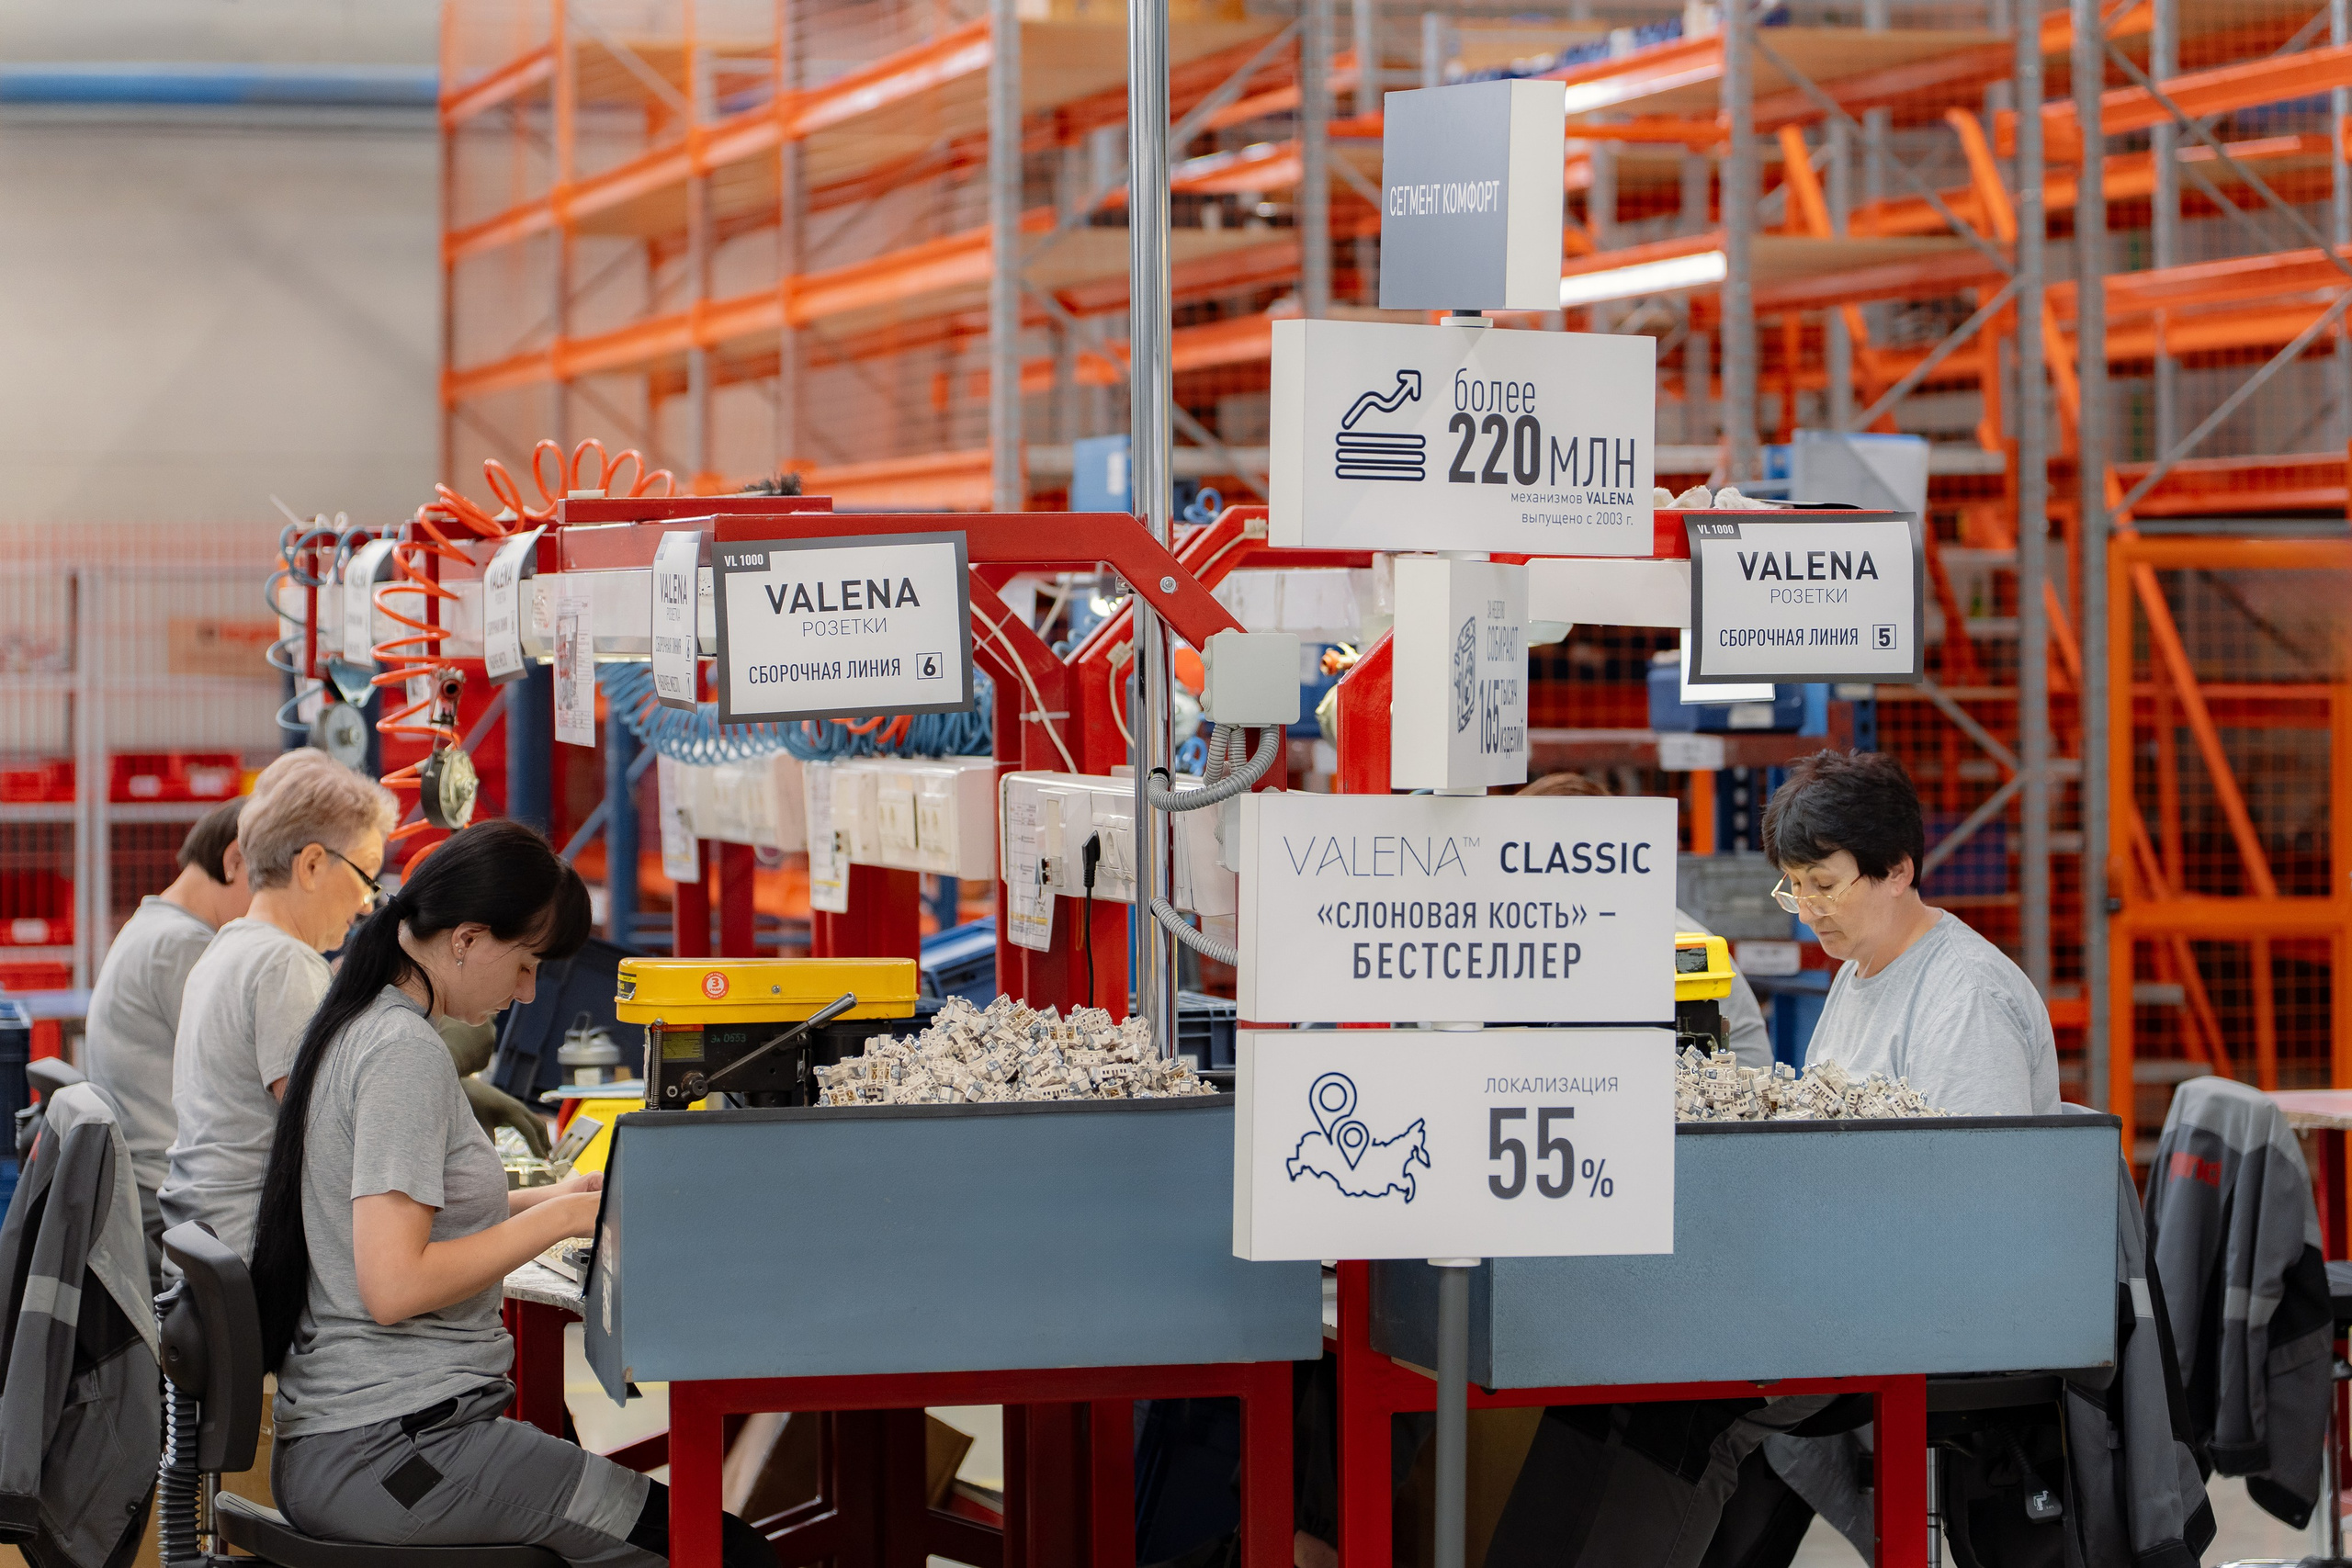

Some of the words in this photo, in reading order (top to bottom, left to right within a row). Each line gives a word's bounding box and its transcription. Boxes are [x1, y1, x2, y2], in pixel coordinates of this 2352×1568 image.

[1389, 183, 1441, 217] СЕГМЕНТ
[1442, 179, 1500, 214] КОМФОРТ
[1454, 367, 1536, 414] более
[1448, 412, 1541, 486] 220
[1510, 492, 1583, 504] механизмов
[1586, 491, 1634, 506] VALENA
[1521, 513, 1583, 527] выпущено
[1586, 515, 1593, 525] с
[1596, 512, 1623, 525] 2003
[1626, 515, 1634, 526] г.
[1696, 524, 1710, 535] VL
[1711, 524, 1735, 535] 1000
[724, 555, 737, 568] VL
[739, 553, 764, 567] 1000
[1736, 550, 1879, 581] VALENA
[660, 573, 687, 604] VALENA
[764, 577, 921, 615] VALENA
[1770, 588, 1849, 604] РОЗЕТКИ
[802, 616, 888, 637] РОЗЕТКИ
[1719, 628, 1804, 647] СБОРОЧНАЯ
[1808, 627, 1859, 646] ЛИНИЯ
[1878, 627, 1891, 647] 5
[1487, 625, 1519, 661] СОБИРАЮТ
[749, 660, 842, 684] СБОРОЧНАЯ
[846, 658, 900, 679] ЛИНИЯ
[922, 656, 936, 677] 6
[1479, 679, 1500, 754] 165
[1499, 717, 1524, 760] изделий
[1499, 841, 1652, 874] CLASSIC
[1353, 942, 1582, 979] БЕСТСЕЛЛЕР
[711, 977, 719, 987] 3
[1484, 1077, 1619, 1096] ЛОКАЛИЗАЦИЯ
